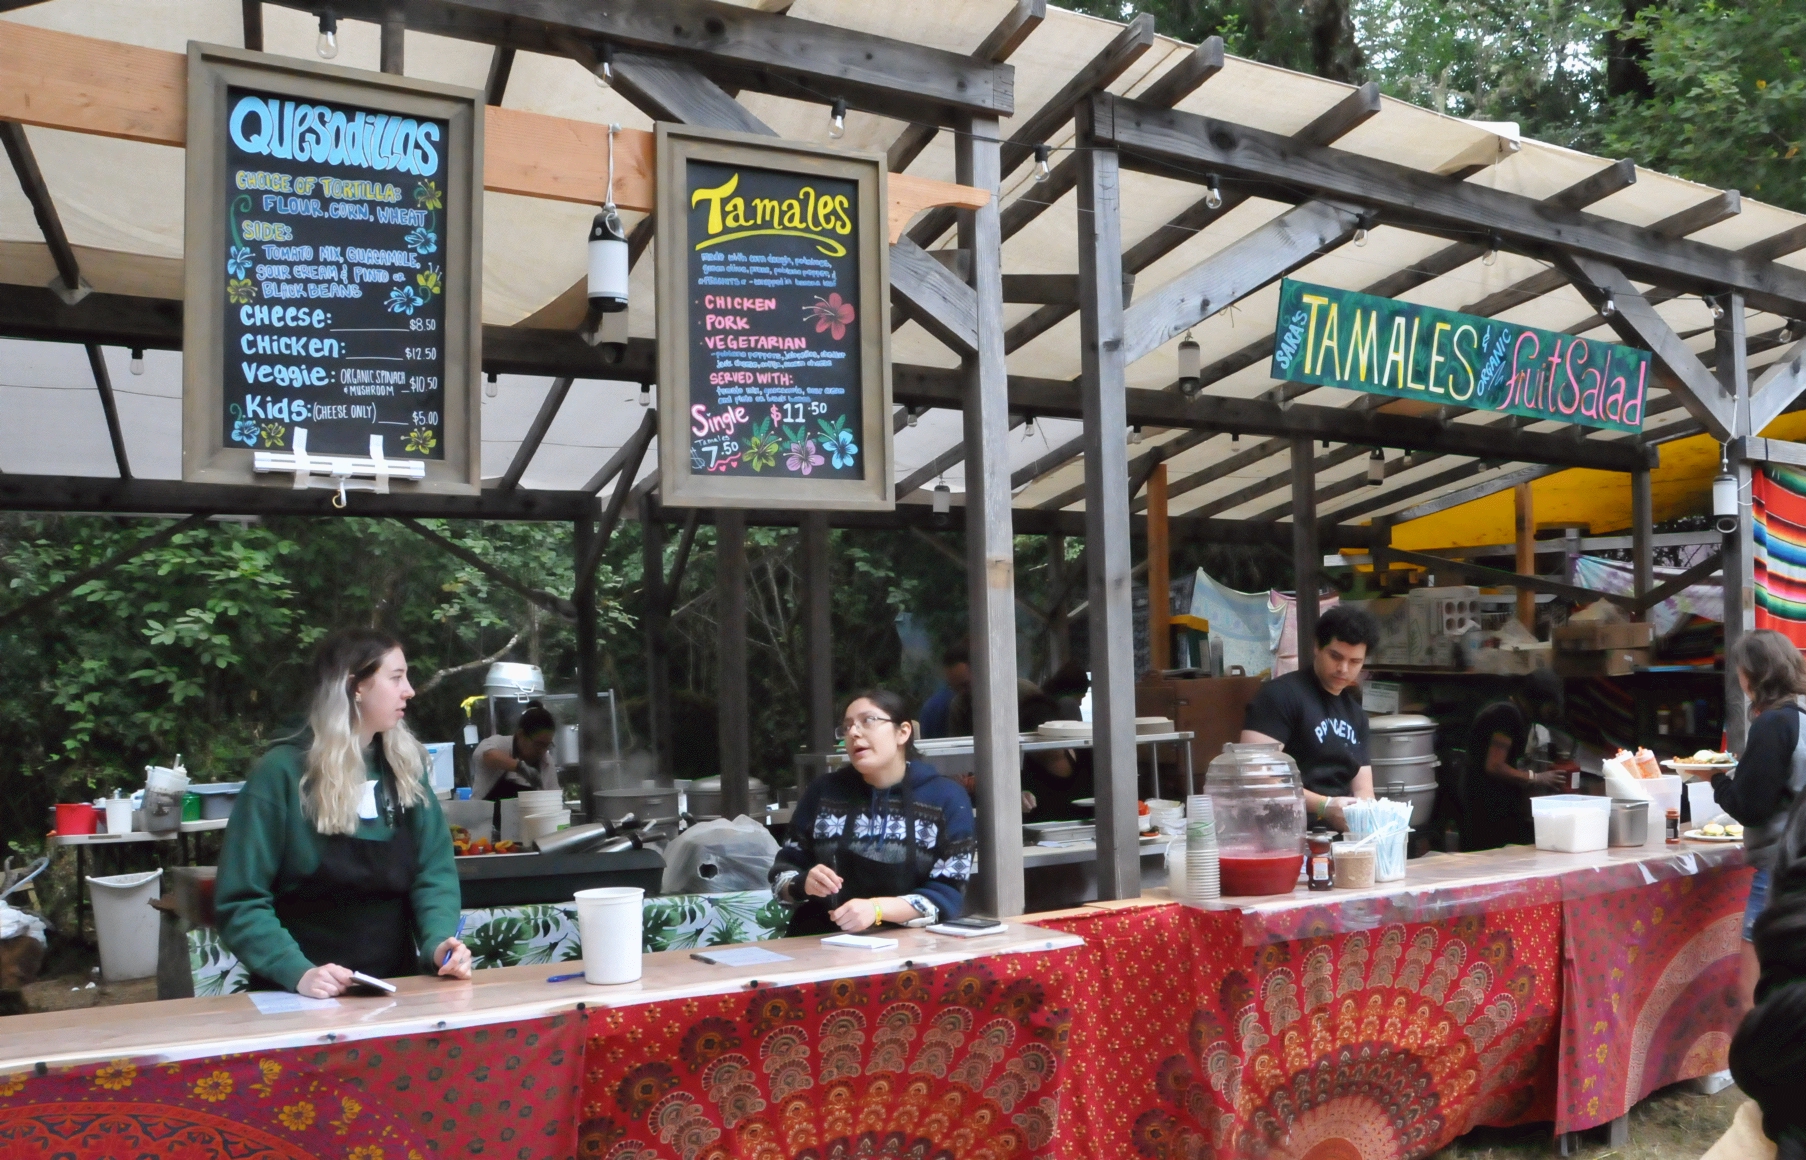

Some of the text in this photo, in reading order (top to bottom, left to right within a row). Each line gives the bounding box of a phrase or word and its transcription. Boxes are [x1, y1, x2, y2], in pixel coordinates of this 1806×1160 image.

[236, 171, 402, 202] CHOICE OF TORTILLA:
[263, 196, 428, 227] FLOUR, CORN, WHEAT
[691, 172, 851, 235] Tamales
[242, 220, 293, 241] SIDE:
[262, 244, 421, 268] TOMATO MIX, GUACAMOLE,
[256, 264, 291, 281] SOUR
[293, 265, 338, 281] CREAM
[353, 266, 389, 283] PINTO
[261, 282, 362, 299] BLACK BEANS
[705, 295, 776, 311] CHICKEN
[409, 318, 436, 332] $8.50
[706, 314, 750, 331] PORK
[705, 335, 806, 350] VEGETARIAN
[1276, 310, 1308, 370] SARA'S
[1303, 294, 1478, 402] TAMALES
[405, 347, 437, 361] $12.50
[1477, 328, 1512, 396] ORGANIC
[340, 368, 374, 384] ORGANIC
[375, 369, 406, 386] SPINACH
[349, 386, 394, 396] MUSHROOM
[409, 376, 438, 393] $10.50
[709, 372, 794, 386] SERVED WITH:
[313, 402, 348, 423] (CHEESE
[350, 401, 377, 423] ONLY)
[412, 411, 439, 426] $5.00
[691, 404, 749, 437] Single
[695, 435, 731, 447] Tamales
